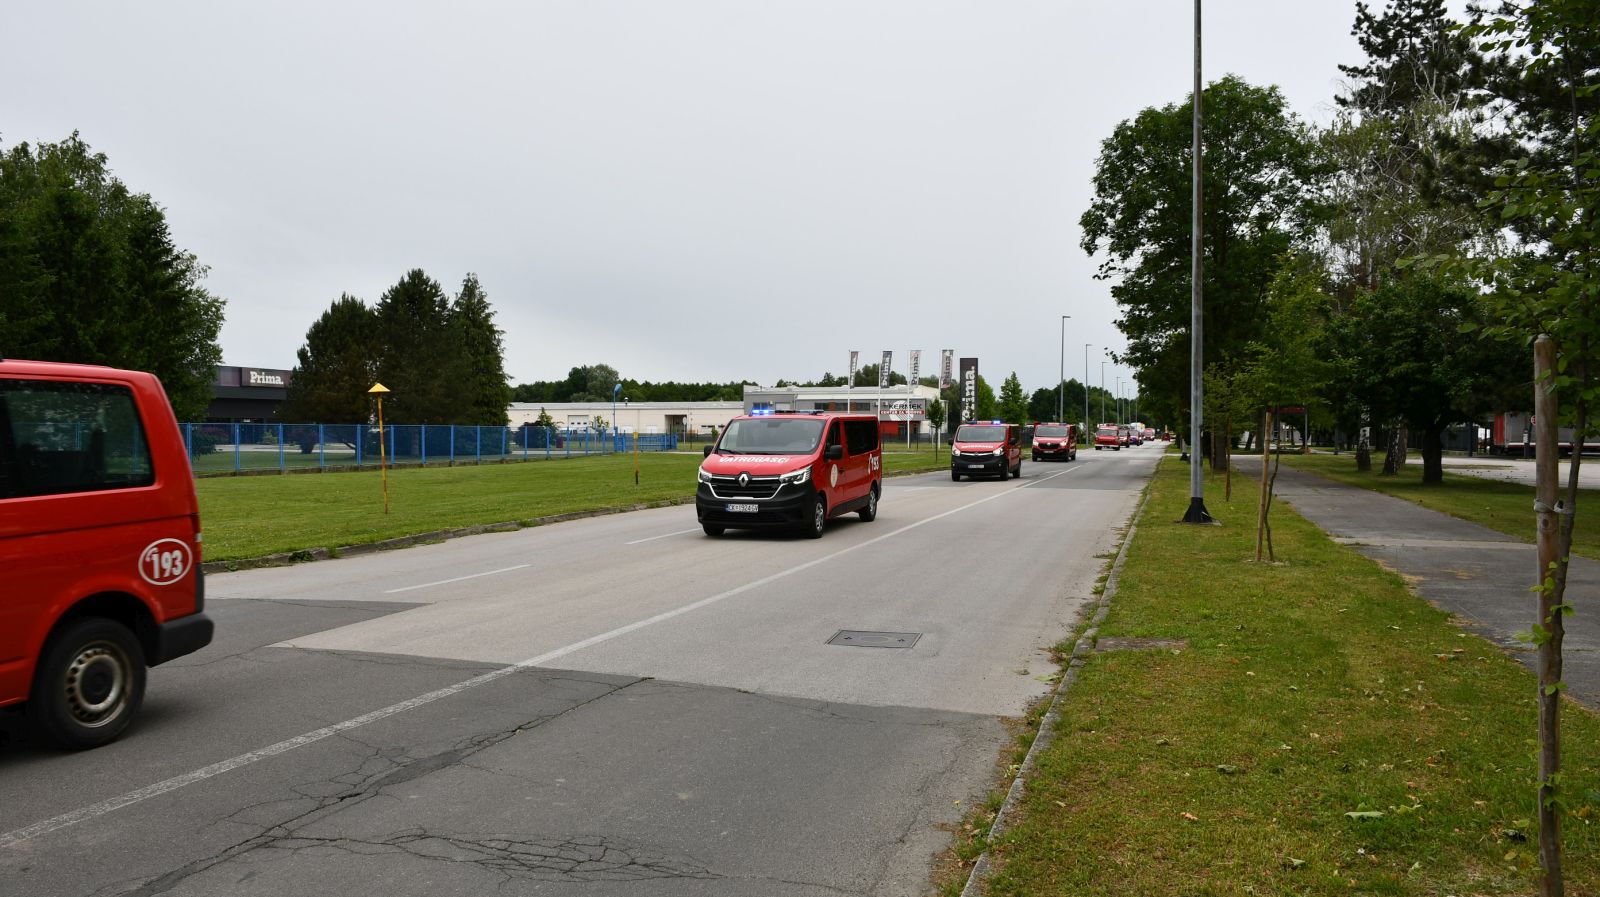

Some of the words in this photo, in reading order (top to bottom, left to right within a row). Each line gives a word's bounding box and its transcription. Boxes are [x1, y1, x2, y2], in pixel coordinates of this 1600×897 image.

[249, 371, 284, 385] Prima.
[719, 456, 790, 464] VATROGASCI
[151, 549, 183, 579] 193
